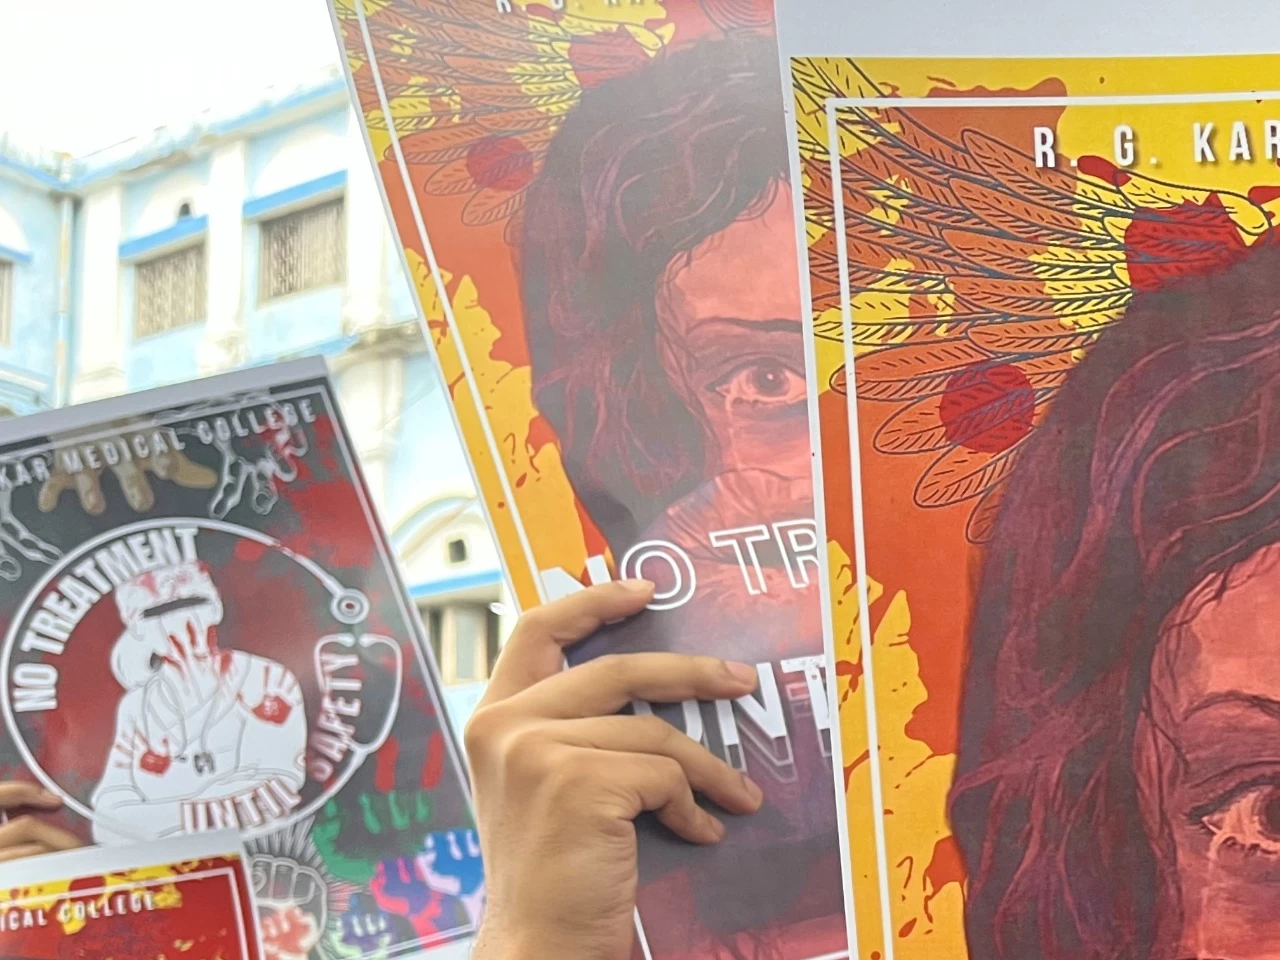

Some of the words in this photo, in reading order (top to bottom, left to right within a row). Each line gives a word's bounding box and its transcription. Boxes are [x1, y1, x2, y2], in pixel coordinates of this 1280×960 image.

[1033, 126, 1078, 168] R.
[1113, 124, 1158, 166] G.
[62, 427, 186, 475] MEDICAL
[196, 398, 317, 445] COLLEGE
[20, 526, 199, 656] TREATMENT
[13, 662, 58, 713] NO
[311, 650, 363, 784] SAFETY
[57, 890, 157, 924] COLLEGE
